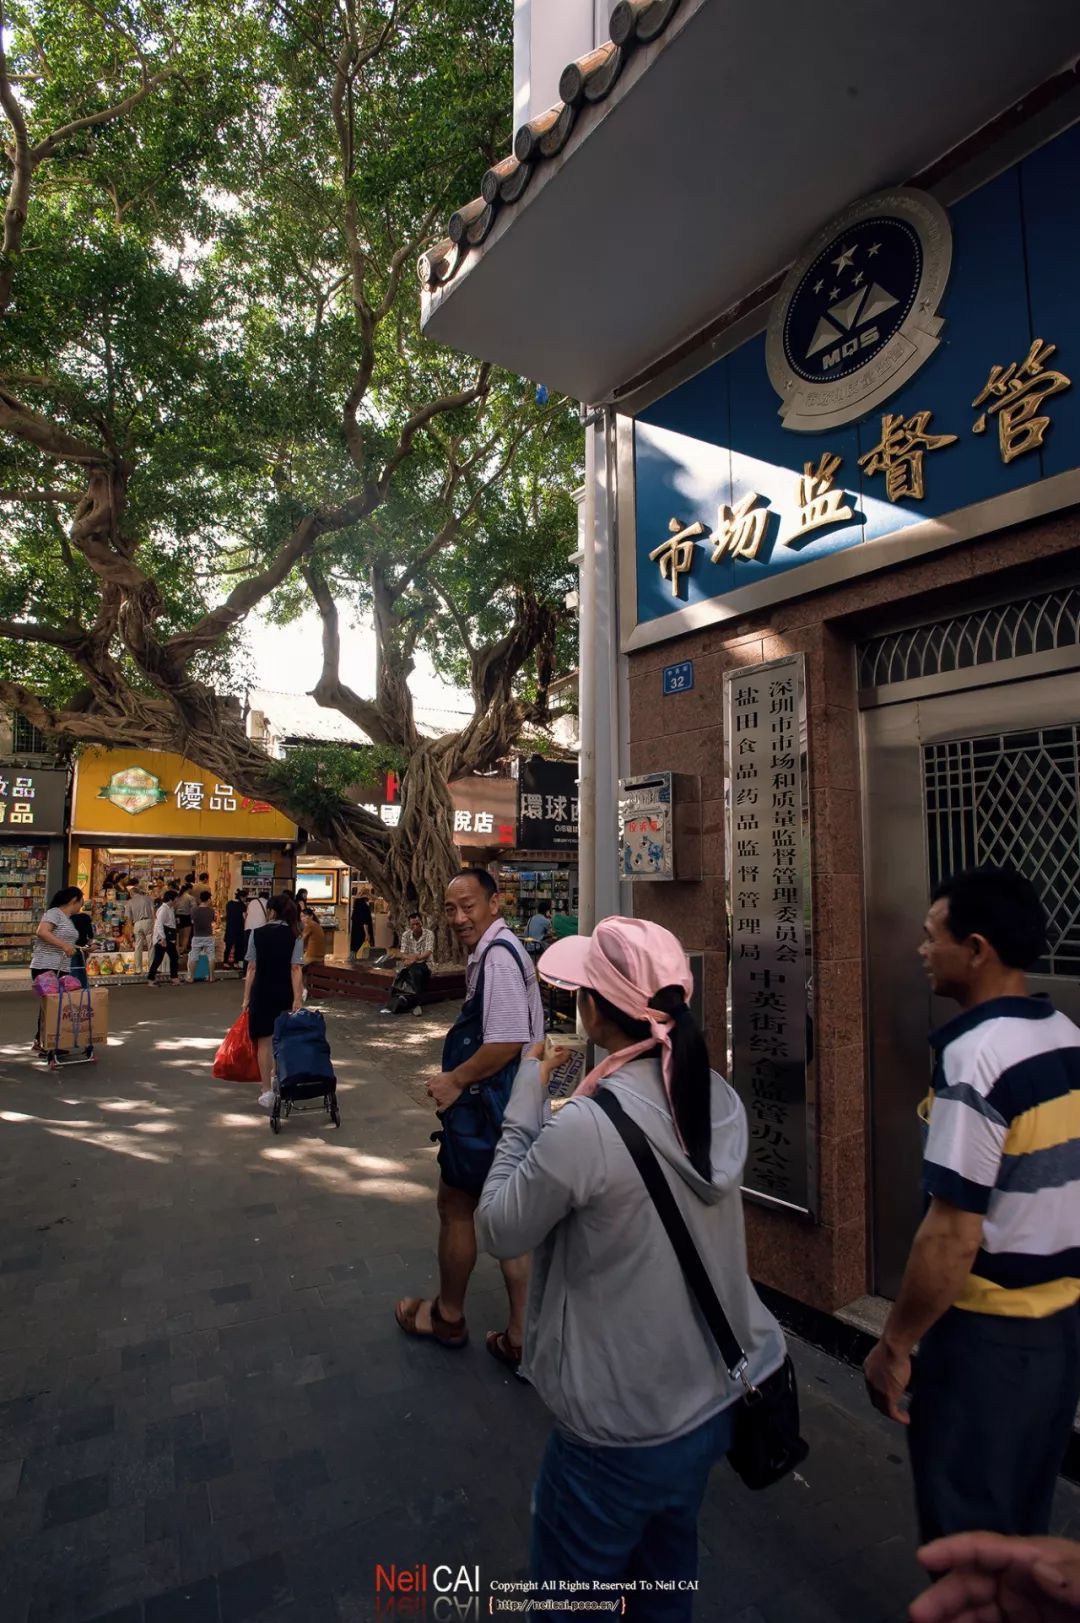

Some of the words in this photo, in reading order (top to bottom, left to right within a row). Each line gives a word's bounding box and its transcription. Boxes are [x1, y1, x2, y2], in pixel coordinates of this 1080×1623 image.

[649, 337, 1073, 598] 市场监督管
[822, 326, 880, 370] MQS
[670, 676, 685, 689] 32
[734, 686, 761, 961] 盐田食品药品监督管理局
[768, 679, 799, 964] 深圳市市场和质量监督管理委员会
[749, 968, 792, 1196] 中英街综合监管办公室
